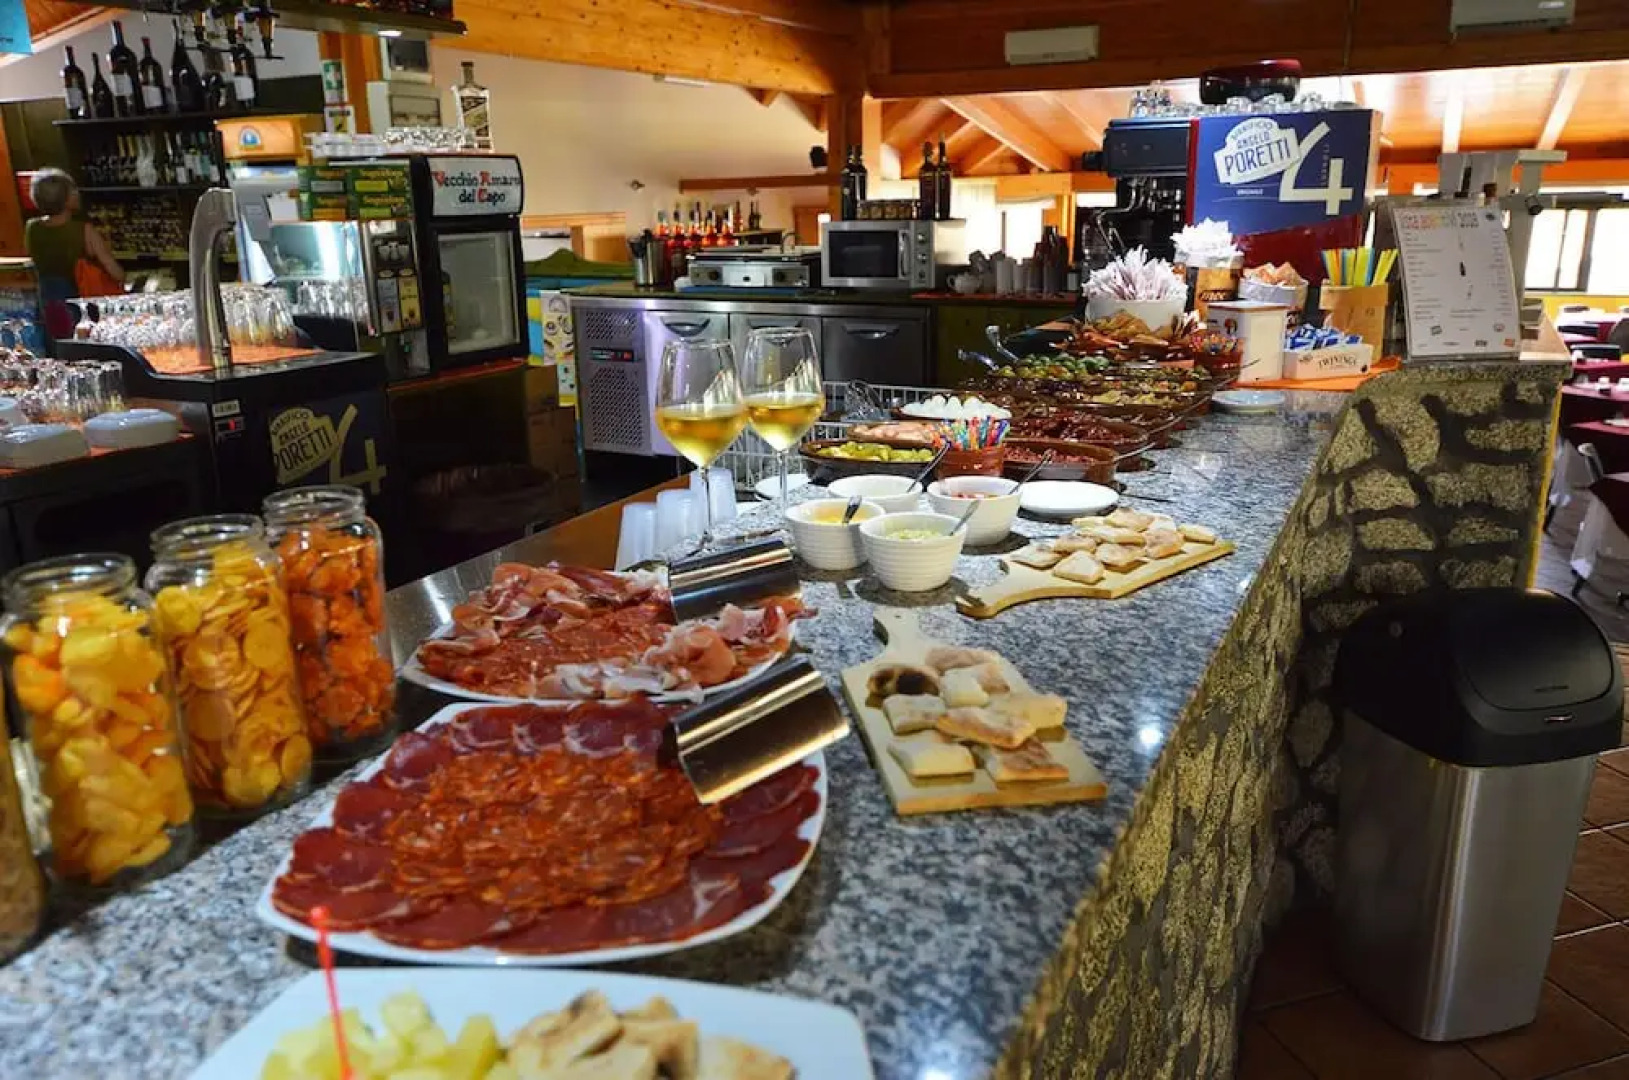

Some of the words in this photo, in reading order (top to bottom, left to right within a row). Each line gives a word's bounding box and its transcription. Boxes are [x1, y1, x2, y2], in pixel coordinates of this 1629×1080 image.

[1237, 131, 1271, 149] ANGELO
[1224, 137, 1291, 177] PORETTI
[1279, 121, 1353, 216] 4
[431, 170, 478, 188] Vecchio
[458, 189, 476, 204] del
[477, 189, 506, 206] Capo
[329, 403, 387, 495] 4
